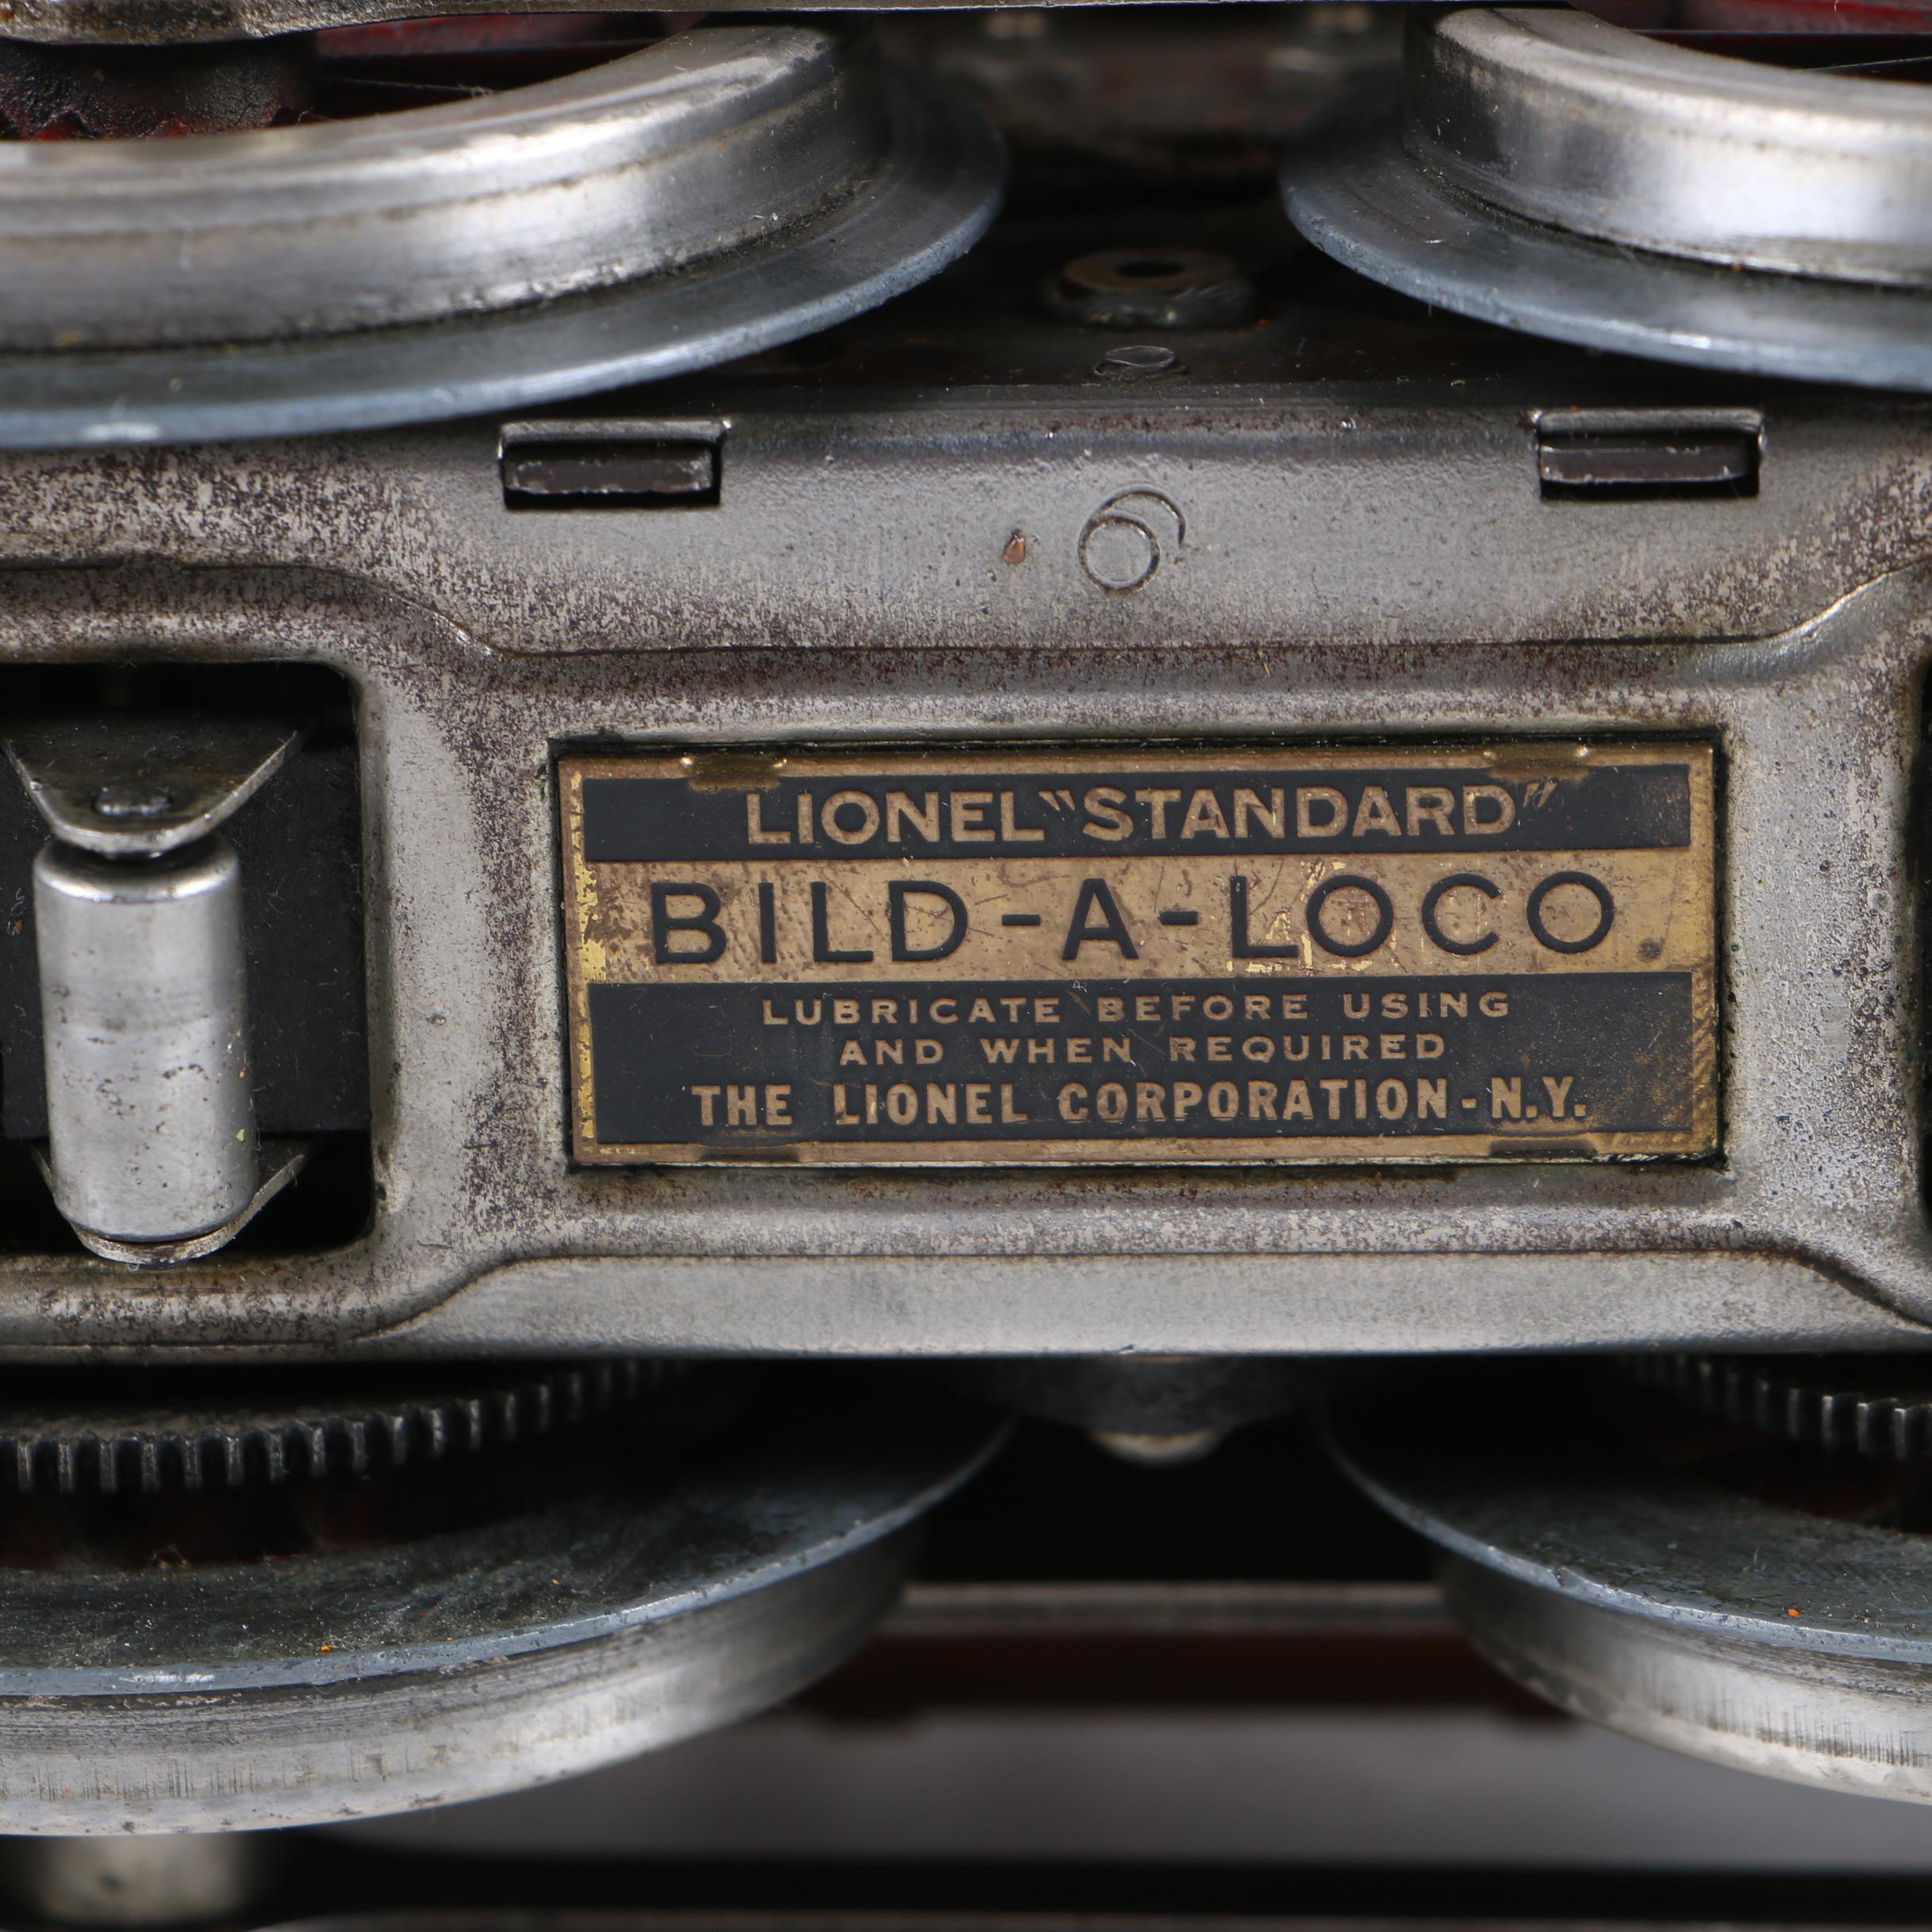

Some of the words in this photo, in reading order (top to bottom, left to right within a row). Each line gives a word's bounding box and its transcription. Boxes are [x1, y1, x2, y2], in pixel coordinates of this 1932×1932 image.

[746, 790, 1046, 844] LIONEL
[650, 871, 1615, 964] BILD-A-LOCO
[762, 997, 1061, 1026] LUBRICATE
[1098, 994, 1309, 1022] BEFORE
[1343, 991, 1509, 1019] USING
[840, 1039, 945, 1066] AND
[980, 1037, 1132, 1065] WHEN
[1169, 1034, 1446, 1062] REQUIRED
[691, 1085, 794, 1126] THE
[833, 1083, 1028, 1125] LIONEL
